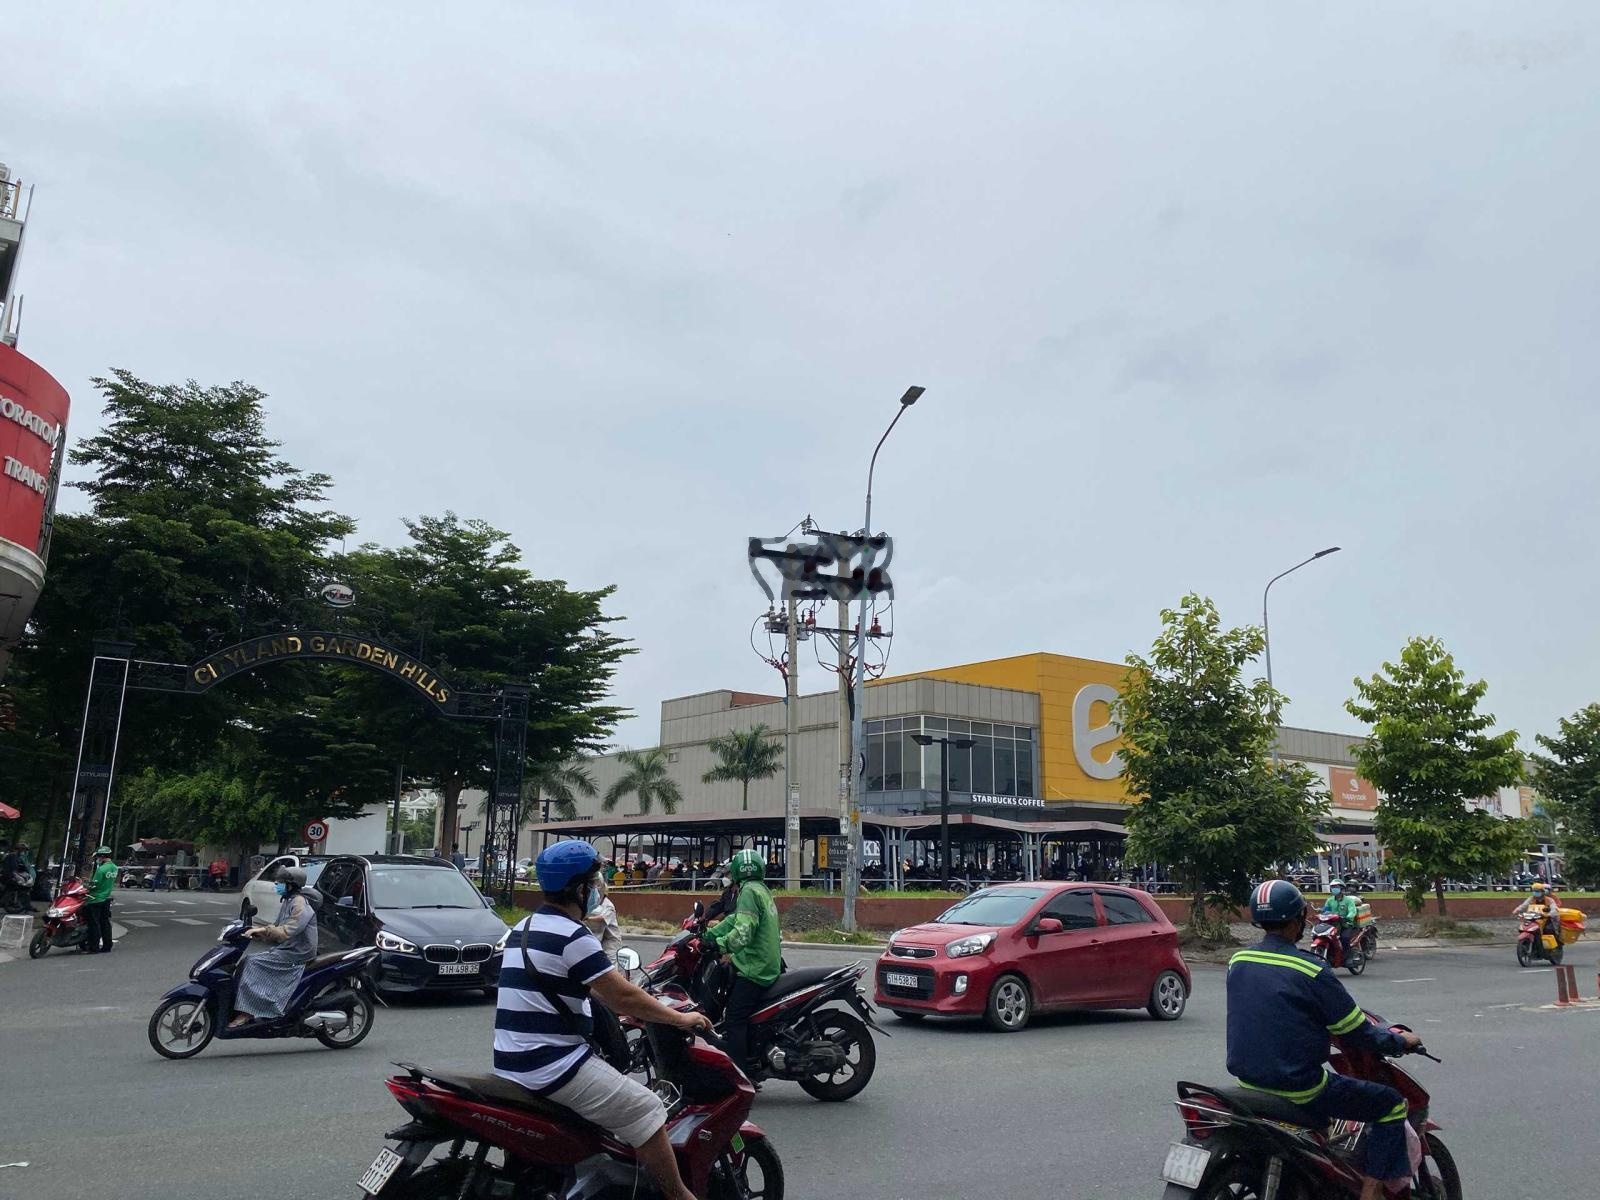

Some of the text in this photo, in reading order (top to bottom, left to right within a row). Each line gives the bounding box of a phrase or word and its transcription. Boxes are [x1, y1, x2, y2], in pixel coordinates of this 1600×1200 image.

[310, 636, 398, 669] GARDEN
[400, 661, 448, 703] HILLS
[972, 794, 1046, 807] STARBUCKS COFFEE
[309, 826, 322, 836] 30
[739, 864, 758, 872] Grab
